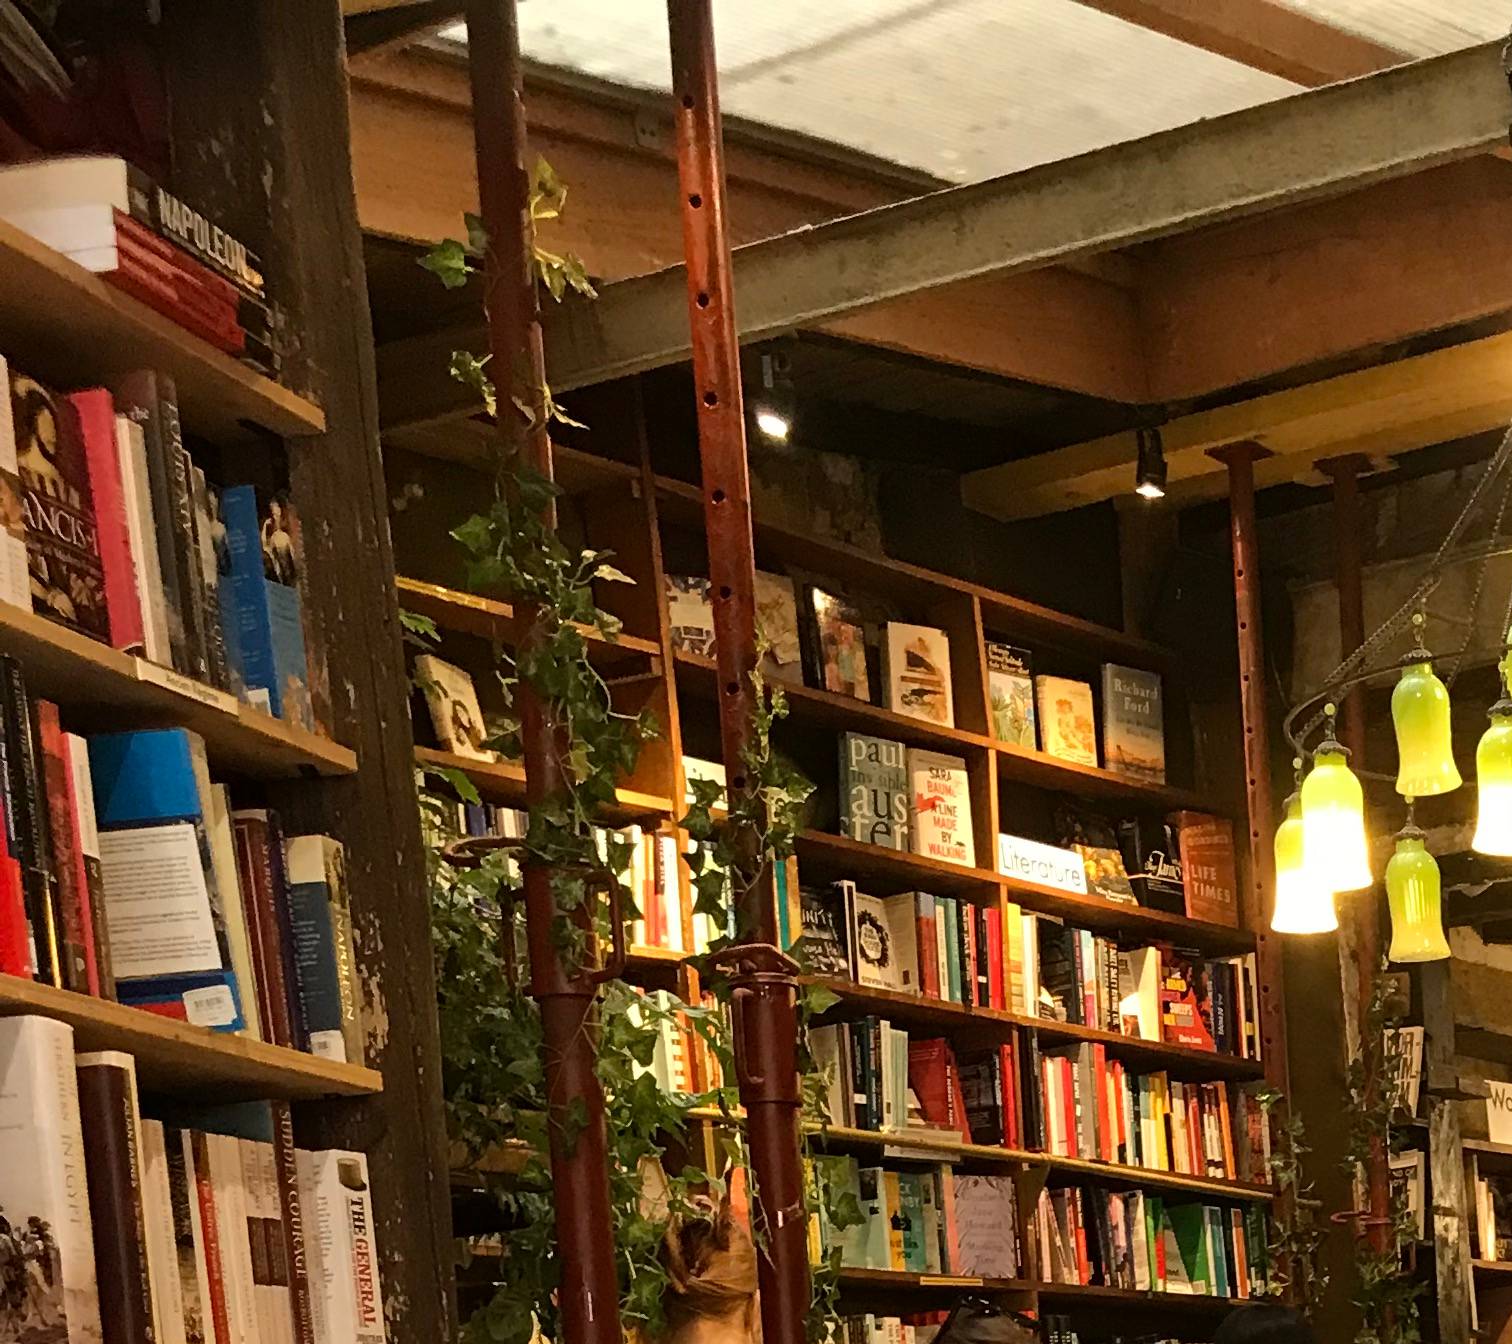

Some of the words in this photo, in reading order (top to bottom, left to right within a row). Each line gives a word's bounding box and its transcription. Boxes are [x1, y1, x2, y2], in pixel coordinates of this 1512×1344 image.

[158, 186, 248, 281] NAPOLEON
[1113, 678, 1159, 699] Richard
[1123, 696, 1150, 715] Ford
[850, 737, 906, 771] paul
[929, 766, 952, 782] SARA
[1000, 840, 1081, 888] Literature
[1190, 864, 1217, 881] LIFE
[279, 1108, 298, 1186] SUDDEN
[350, 1196, 367, 1237] THE
[287, 1195, 307, 1280] COURAGE
[354, 1238, 377, 1328] GENERAL
